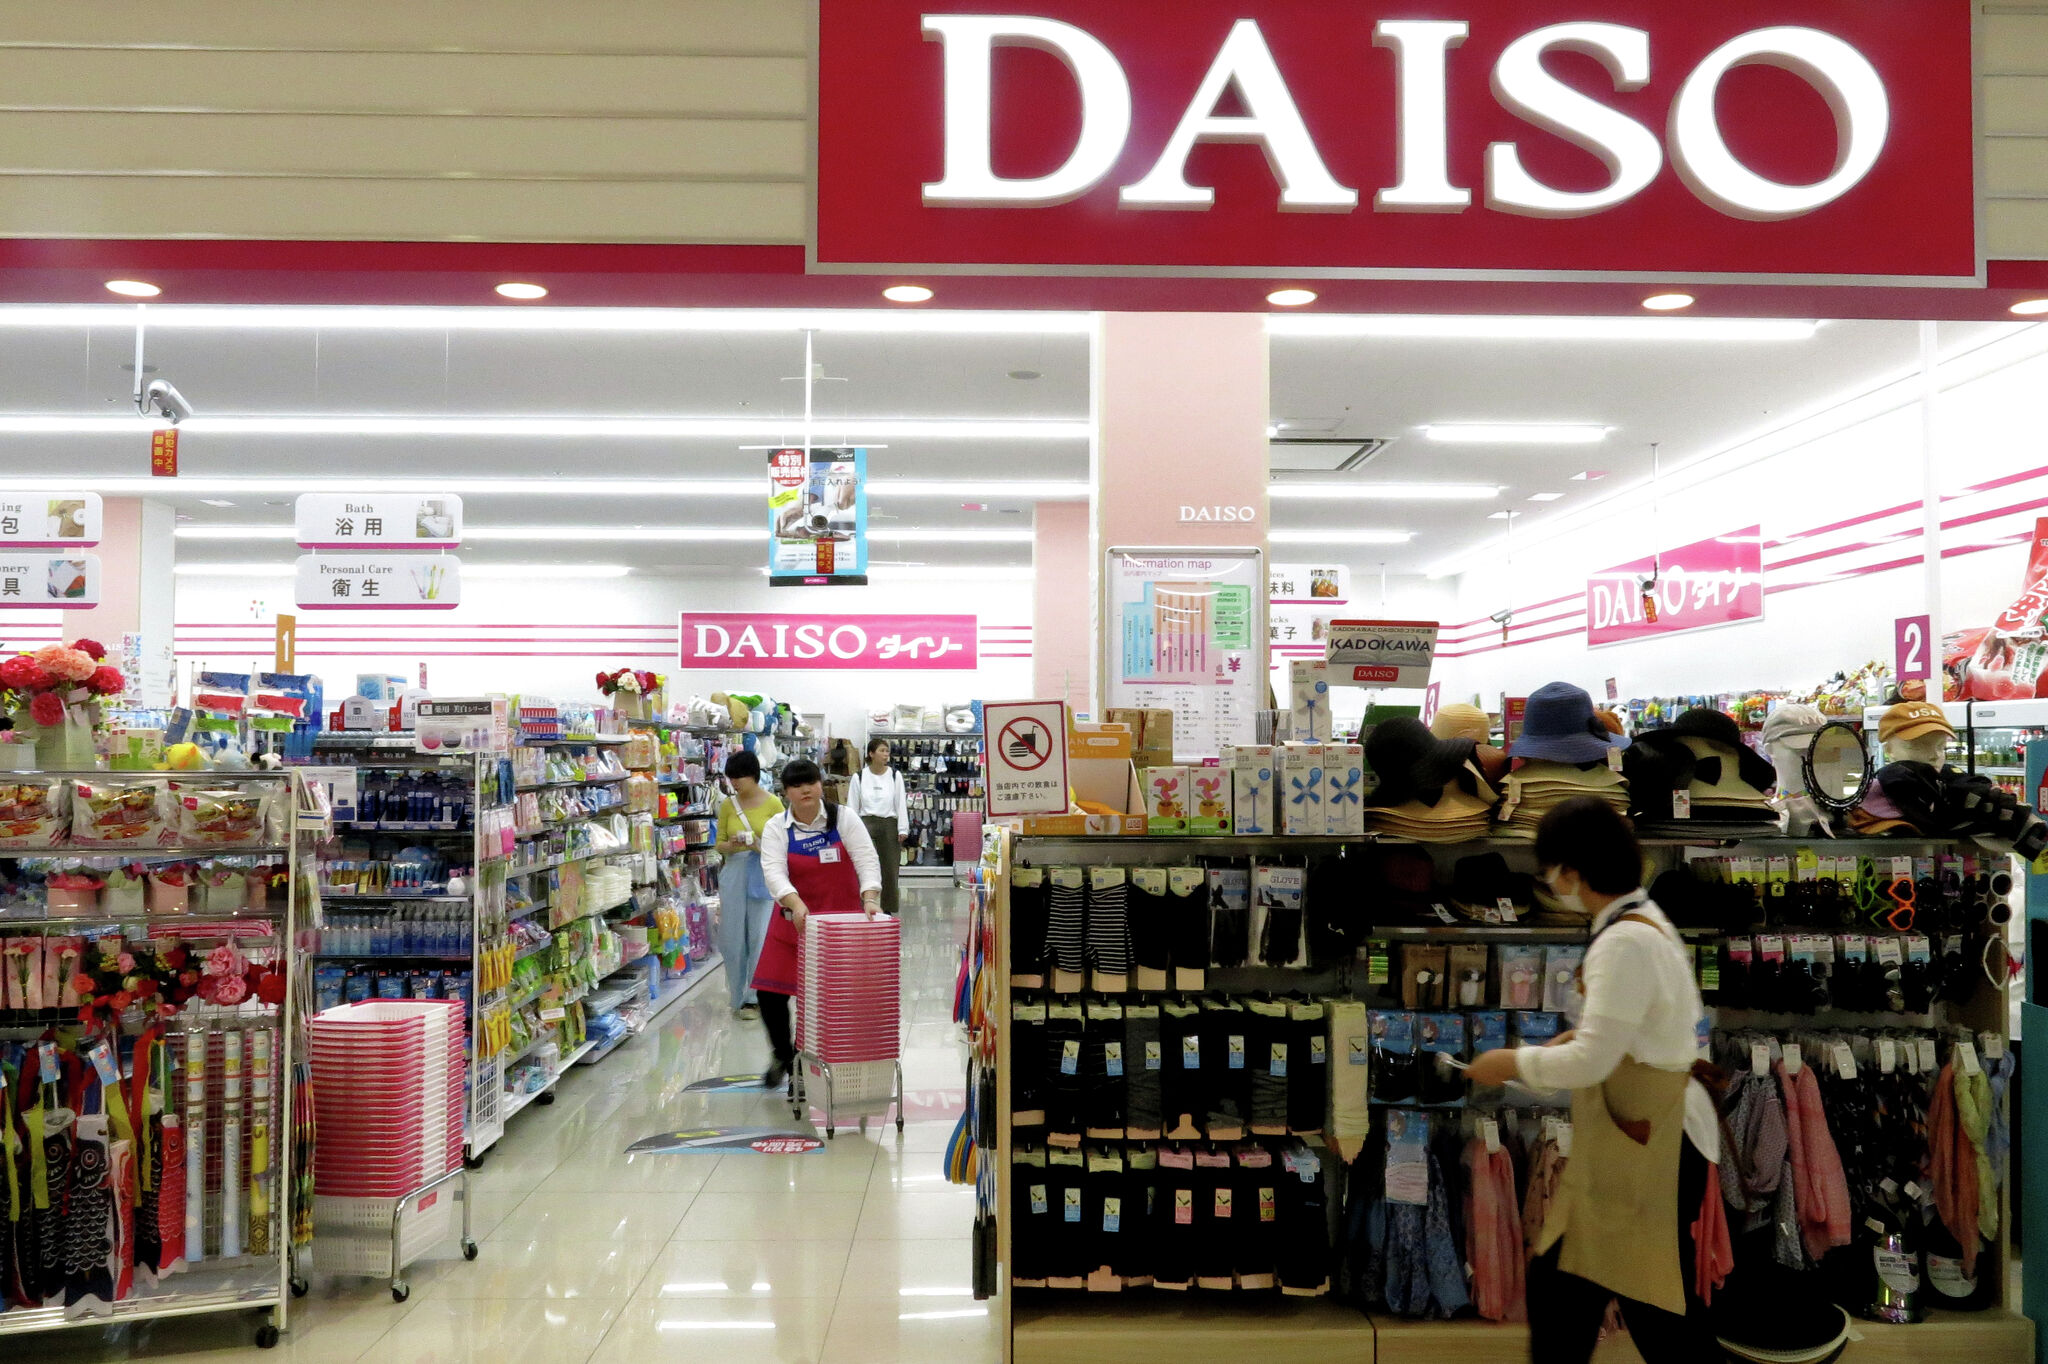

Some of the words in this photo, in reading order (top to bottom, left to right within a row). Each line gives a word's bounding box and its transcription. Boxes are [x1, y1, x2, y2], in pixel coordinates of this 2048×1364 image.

[920, 13, 1891, 221] DAISO
[778, 454, 802, 466] 特別
[345, 504, 374, 513] Bath
[1179, 506, 1256, 522] DAISO
[335, 518, 382, 536] 浴用
[0, 565, 30, 575] nery
[320, 564, 365, 575] Personal
[368, 564, 393, 574] Care
[1187, 560, 1212, 571] map
[2, 578, 21, 596] 具
[332, 578, 380, 597] 衛生
[282, 630, 290, 662] 1
[693, 624, 868, 659] DAISO
[876, 634, 963, 659] ダイソー
[1330, 638, 1431, 652] KADOKAWA
[1904, 623, 1923, 673] 2
[1358, 670, 1395, 678] DAISO
[1426, 688, 1436, 728] 3
[1909, 708, 1941, 719] USA
[1287, 754, 1300, 762] USB
[996, 780, 1058, 791] 当店内での飲食は
[802, 837, 825, 849] DAISO
[1270, 875, 1300, 885] GLOVE
